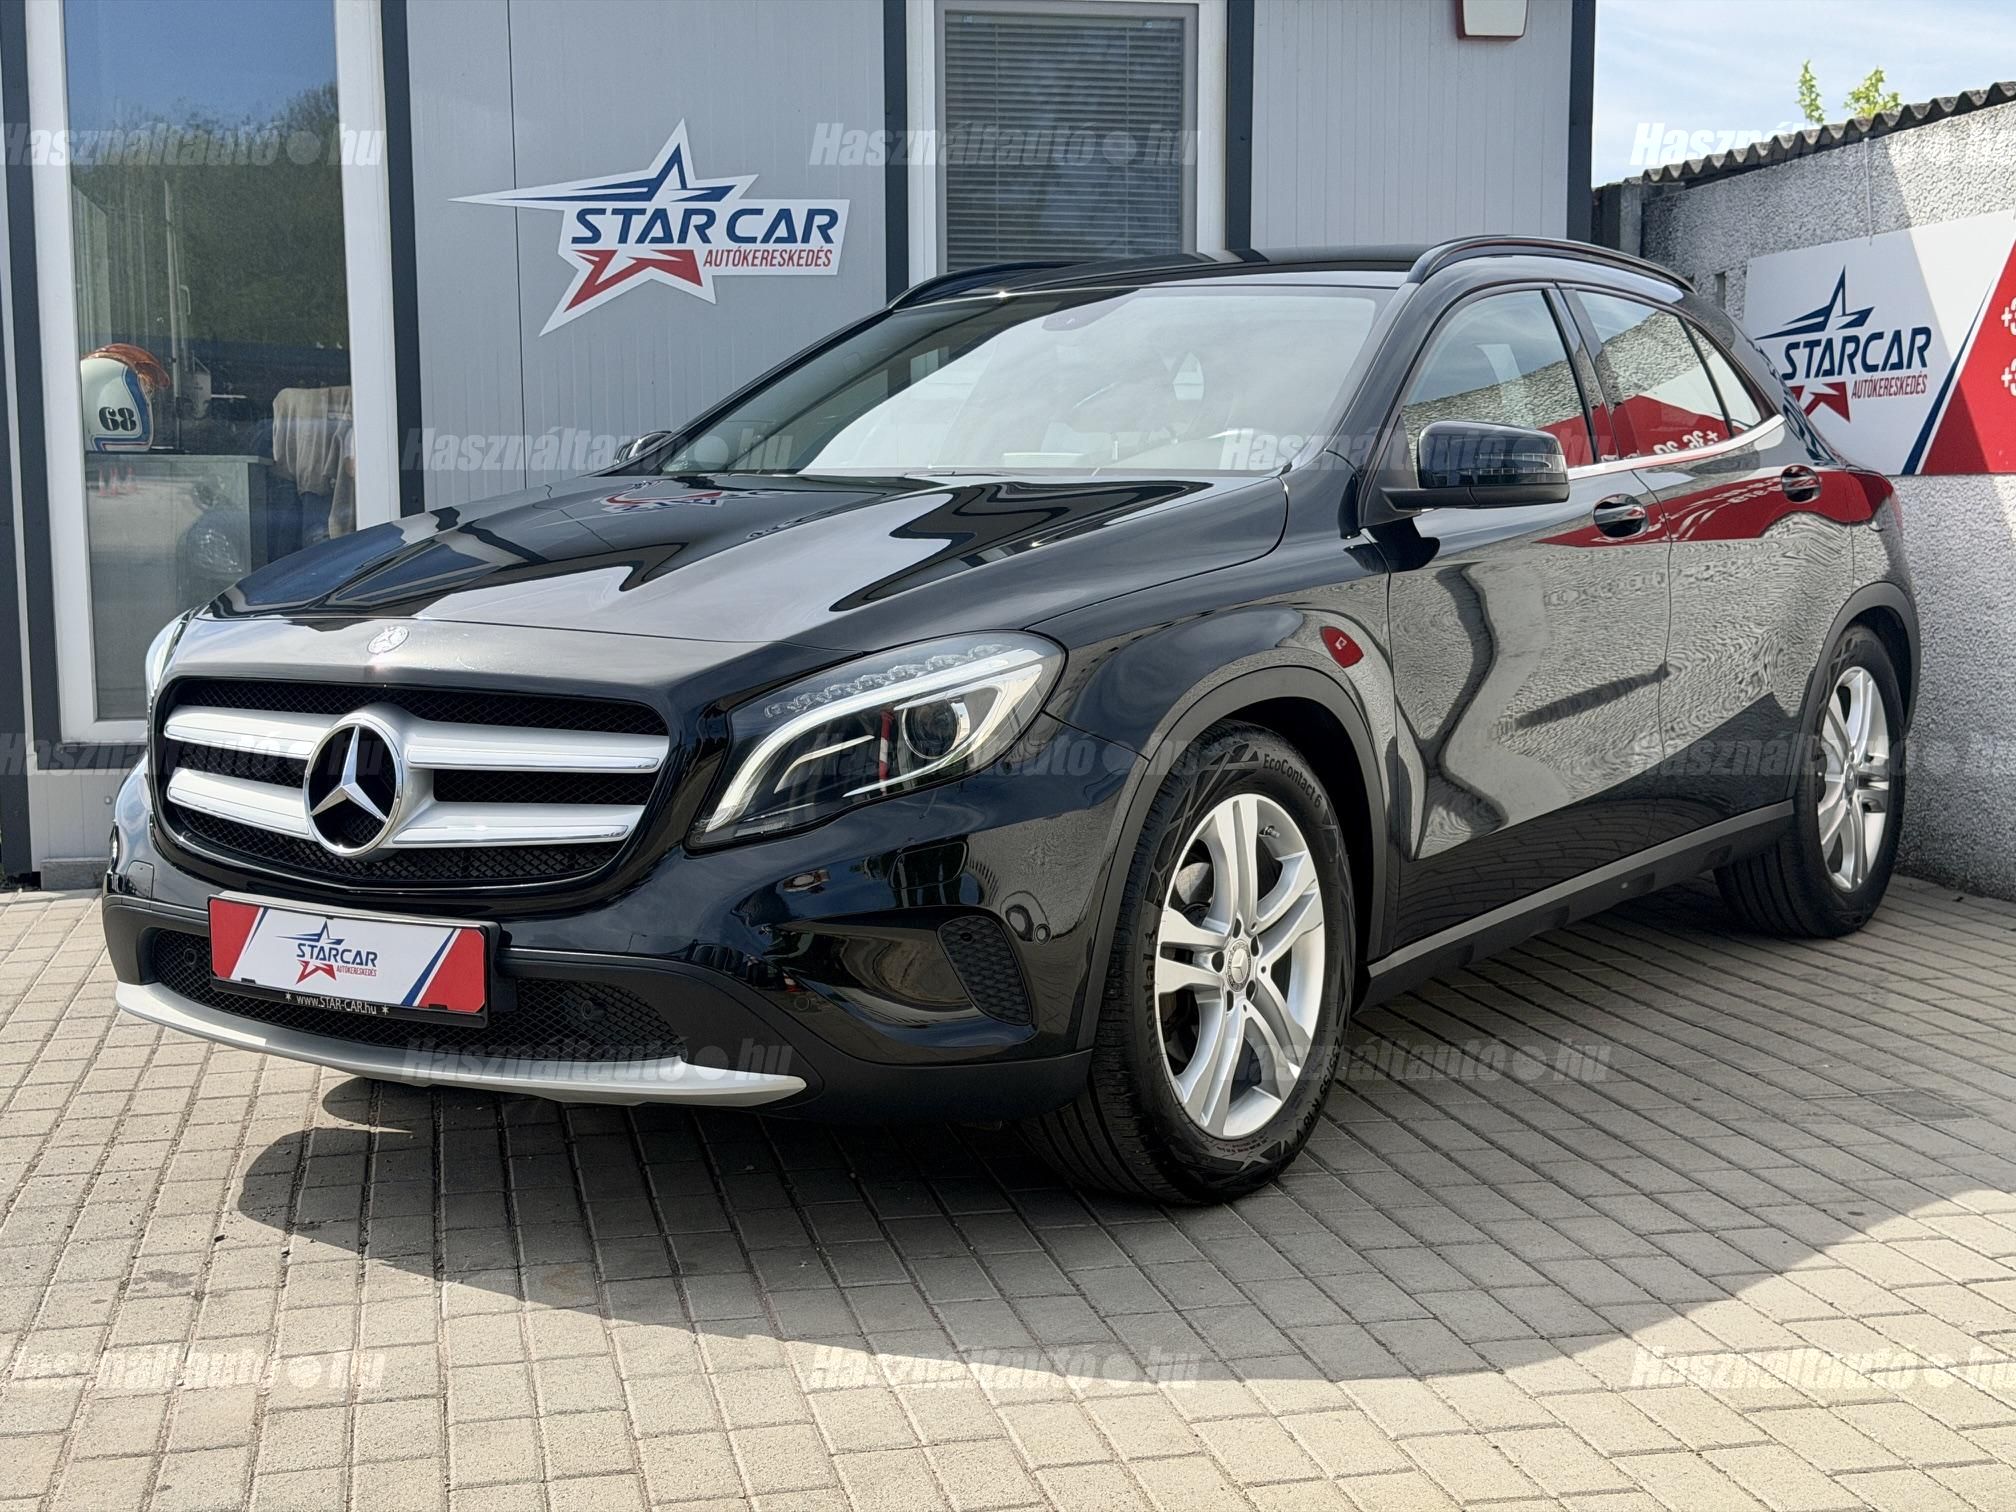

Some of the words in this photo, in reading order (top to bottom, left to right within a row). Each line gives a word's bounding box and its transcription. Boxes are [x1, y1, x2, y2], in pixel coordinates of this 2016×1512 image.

[703, 246, 833, 268] AUTÓKERESKEDÉS
[1781, 326, 1932, 382] STARCAR
[1851, 371, 1928, 400] AUTÓKERESKEDÉS
[99, 406, 137, 432] 68
[1262, 753, 1317, 801] EcoContact
[1314, 794, 1323, 809] 6
[297, 943, 378, 967] STARCAR
[297, 995, 377, 1015] www.STAR-CAR.hu
